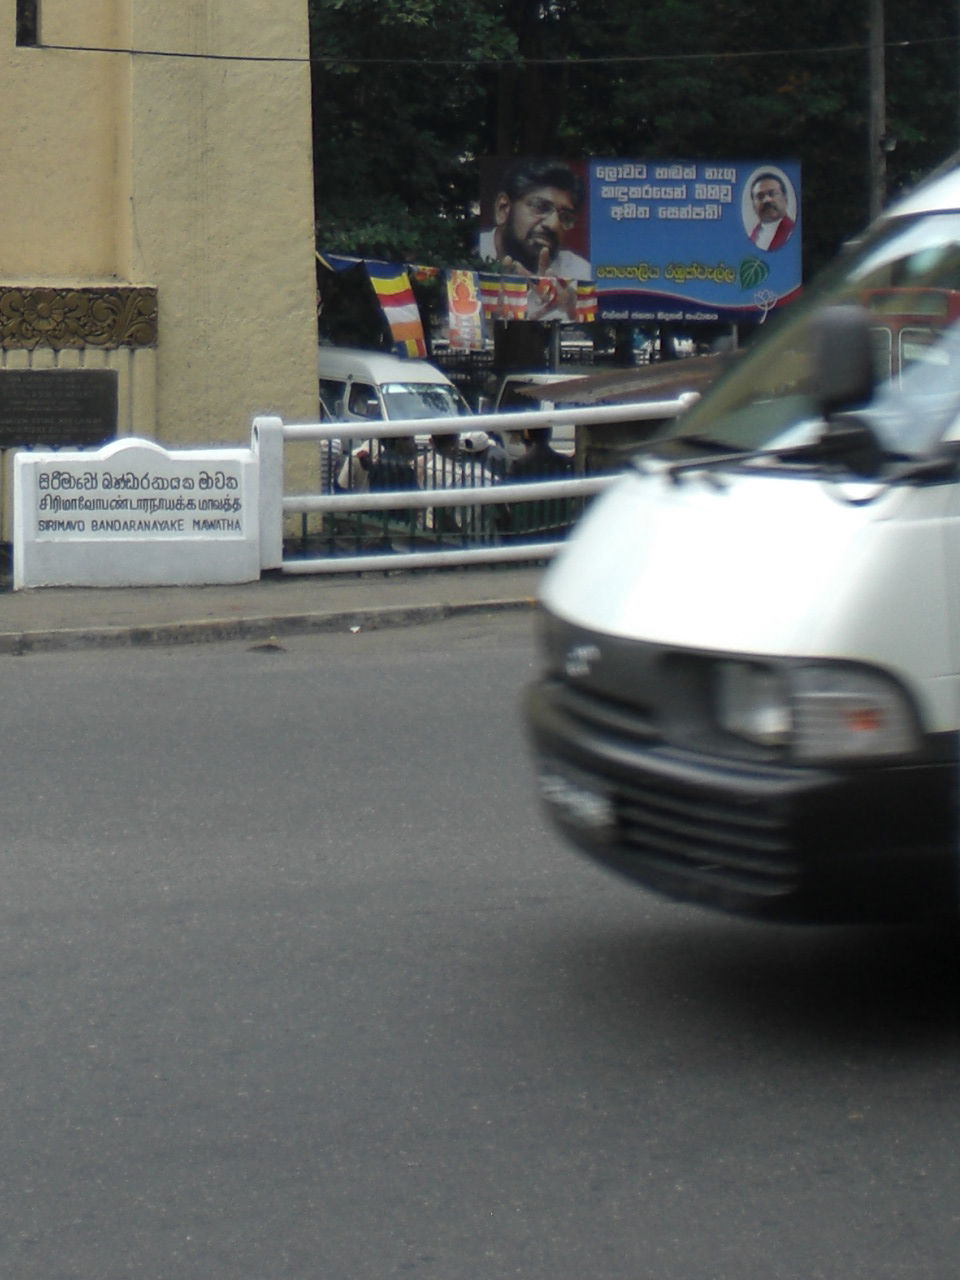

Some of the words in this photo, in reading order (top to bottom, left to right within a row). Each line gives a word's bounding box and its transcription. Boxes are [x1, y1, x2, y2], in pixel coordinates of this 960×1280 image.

[199, 470, 239, 490] මාවත
[38, 519, 86, 532] SIRIMAVO
[91, 518, 185, 532] BANDARANAYAKE
[192, 518, 242, 532] MAWATHA
